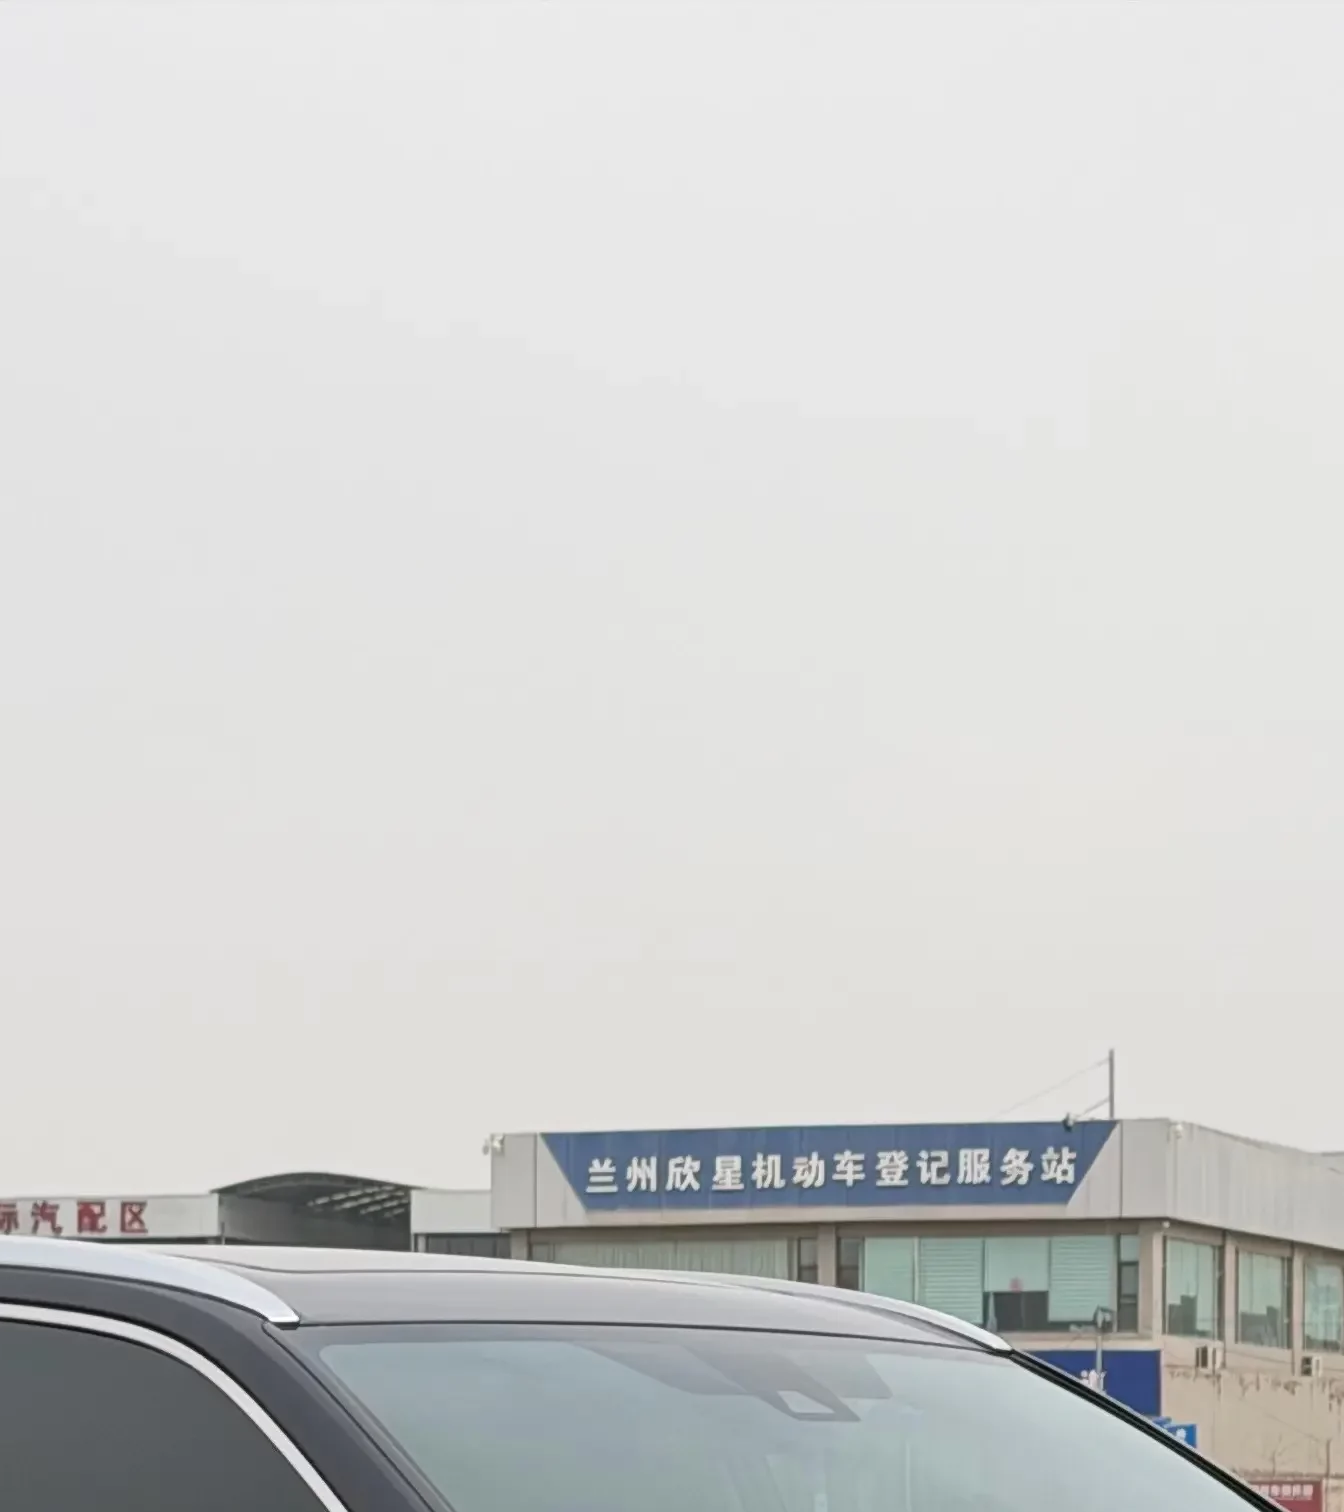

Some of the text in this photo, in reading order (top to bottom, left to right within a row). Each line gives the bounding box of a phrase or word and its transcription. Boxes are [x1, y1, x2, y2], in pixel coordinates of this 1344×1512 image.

[586, 1146, 1078, 1194] 兰州欣星机动车登记服务站
